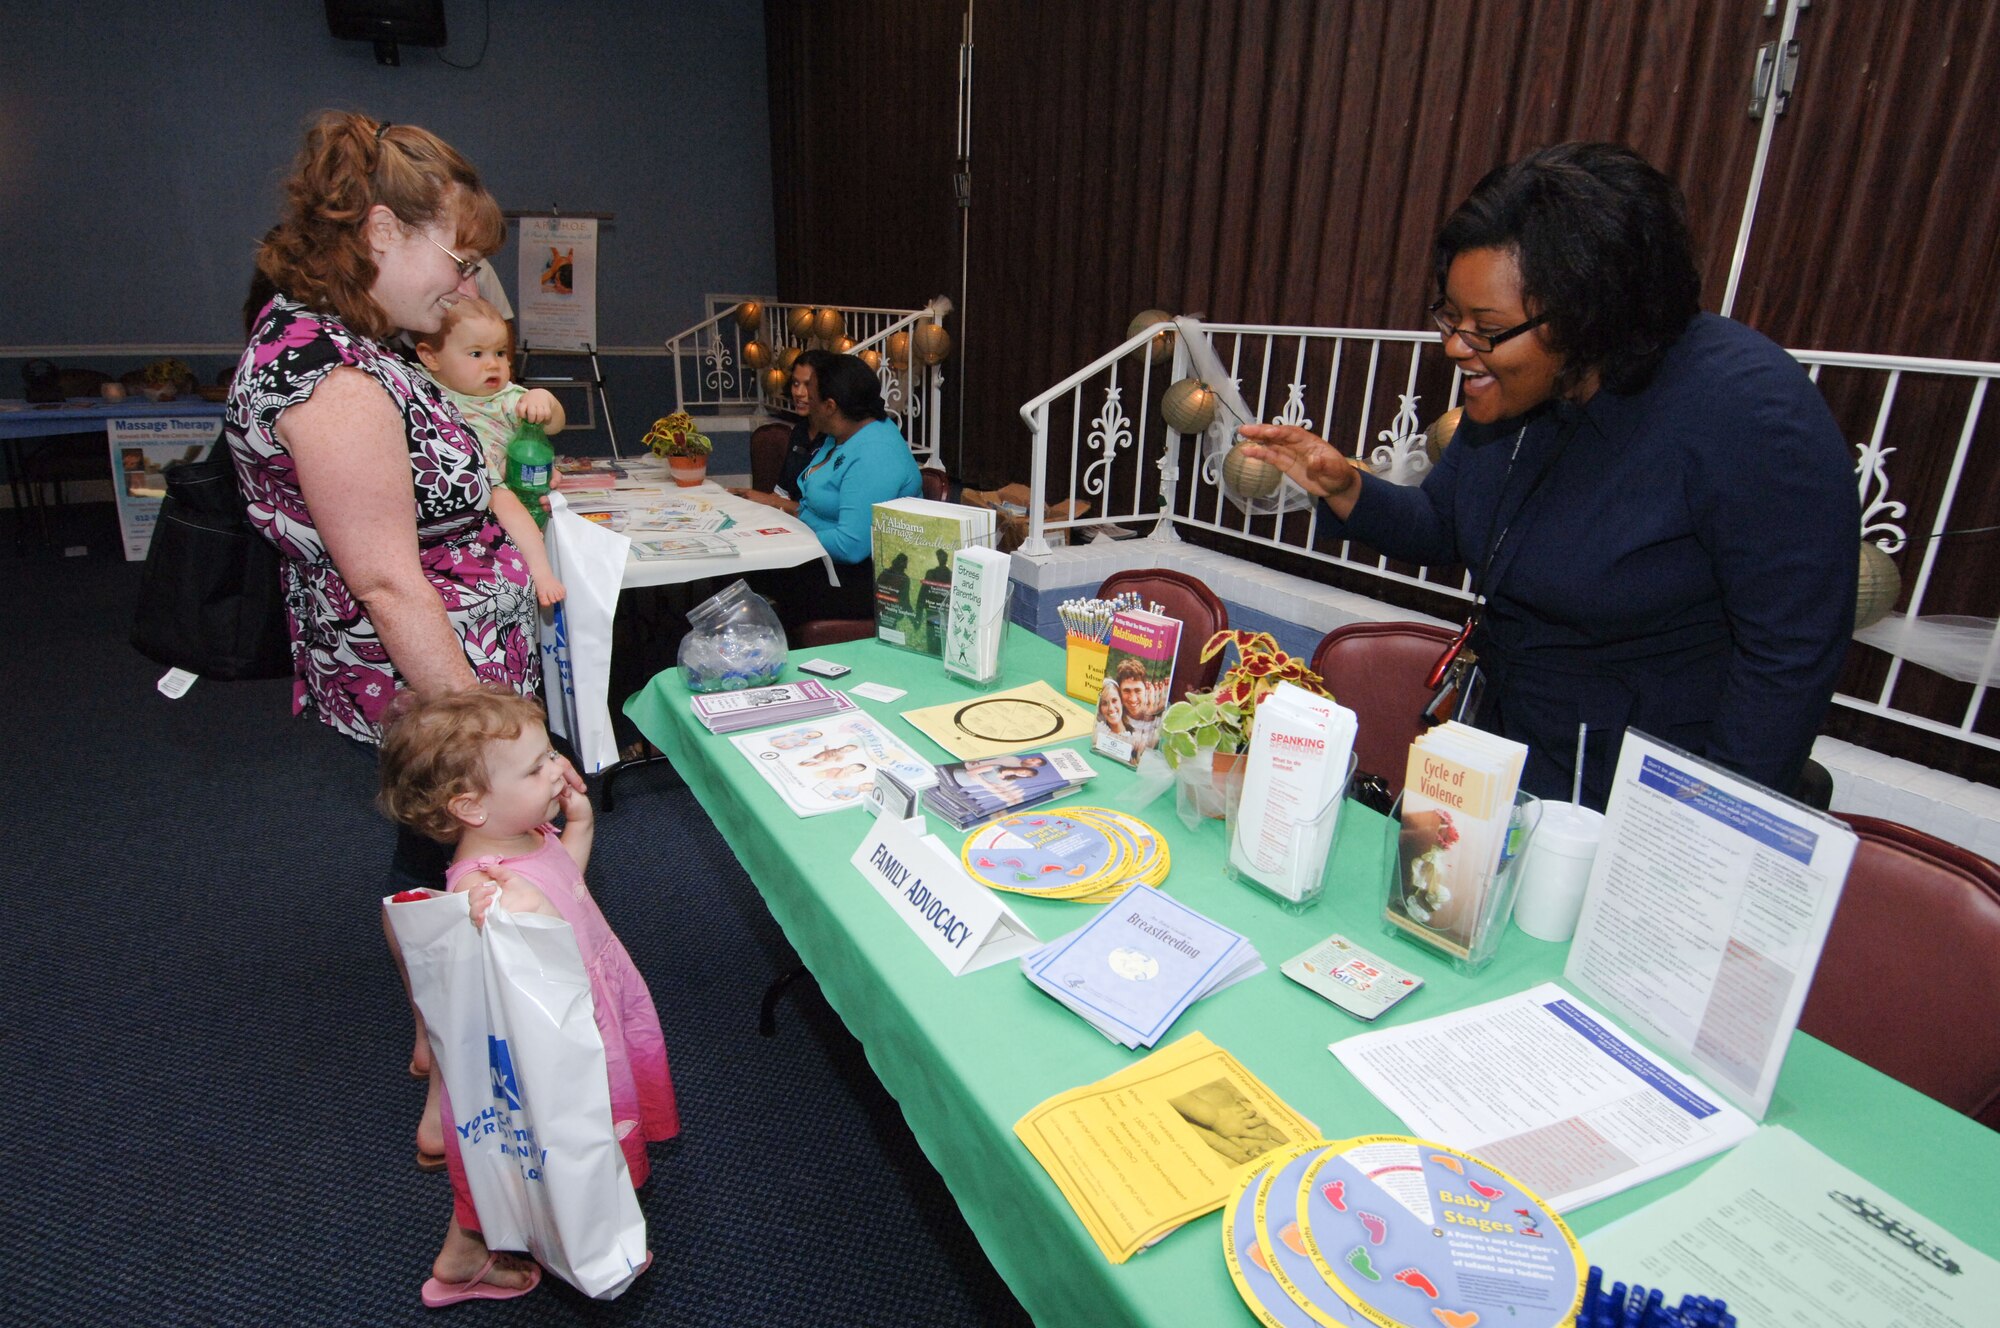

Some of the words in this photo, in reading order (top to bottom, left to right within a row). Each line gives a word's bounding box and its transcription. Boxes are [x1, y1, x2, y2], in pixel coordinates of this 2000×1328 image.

[115, 420, 168, 432] Massage
[170, 419, 216, 432] Therapy
[874, 517, 914, 541] Marriage
[887, 516, 924, 534] Alabama
[958, 564, 980, 580] Stress
[953, 586, 982, 606] Parenting
[962, 580, 974, 590] and
[1112, 624, 1153, 649] Relationships
[1088, 664, 1106, 675] Famil
[1270, 732, 1325, 749] SPANKING
[1272, 756, 1287, 765] What
[1424, 758, 1448, 781] Cycle
[1452, 771, 1466, 787] of
[1420, 776, 1463, 808] Violence
[868, 842, 911, 880] FAMILY
[904, 878, 973, 948] ADVOCACY
[1126, 912, 1200, 959] Breastfeeding
[1350, 960, 1380, 976] 25
[1329, 968, 1371, 991] KIDS
[1218, 1055, 1264, 1102] Breastfeeding
[1262, 1096, 1294, 1130] Support
[1292, 1126, 1308, 1142] Gro
[1309, 1159, 1327, 1178] Months
[1473, 1158, 1506, 1178] Months
[1260, 1175, 1275, 1198] Months
[1258, 1198, 1264, 1206] 18
[1439, 1190, 1491, 1212] Baby
[1258, 1214, 1264, 1223] 12
[1443, 1211, 1514, 1233] Stages
[1304, 1226, 1319, 1256] Months
[1455, 1231, 1489, 1244] Parent's
[1491, 1237, 1507, 1247] and
[1557, 1222, 1577, 1250] Months
[1448, 1239, 1474, 1251] Guide
[1476, 1244, 1486, 1252] to
[1488, 1244, 1502, 1254] the
[1504, 1248, 1530, 1260] Social
[1532, 1252, 1549, 1262] and
[1450, 1250, 1496, 1264] Emotional
[1497, 1254, 1556, 1272] Development
[1269, 1254, 1290, 1286] Months
[1463, 1260, 1496, 1272] Infants
[1498, 1265, 1515, 1275] and
[1516, 1266, 1554, 1281] Toddlers
[1911, 1272, 1954, 1300] Program
